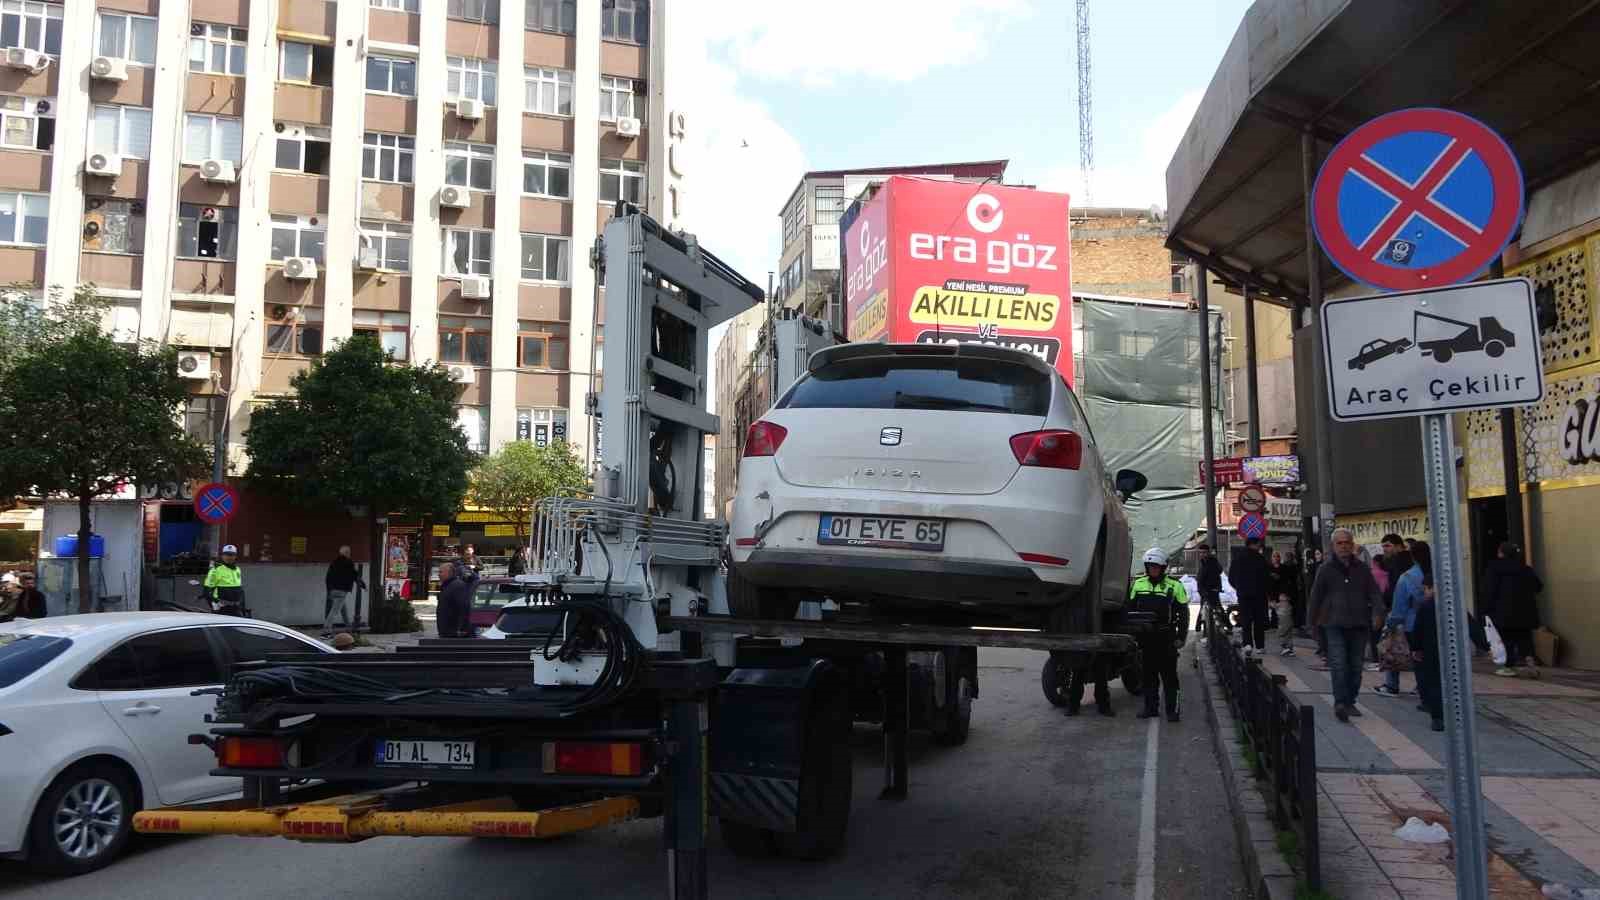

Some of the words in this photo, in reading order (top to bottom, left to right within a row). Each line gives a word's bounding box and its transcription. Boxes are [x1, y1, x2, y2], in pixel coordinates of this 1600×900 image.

[910, 232, 977, 263] era
[986, 233, 1058, 274] göz
[847, 264, 864, 301] era
[988, 285, 1025, 296] PREMIUM
[915, 293, 990, 318] AKILLI
[996, 299, 1054, 323] LENS
[978, 323, 999, 339] VE
[1347, 386, 1409, 405] Araç
[1429, 374, 1526, 401] Çekilir
[831, 518, 851, 537] 01
[860, 519, 907, 540] EYE
[915, 521, 940, 542] 65
[385, 742, 401, 761] 01
[411, 742, 429, 761] AL
[444, 743, 471, 762] 734
